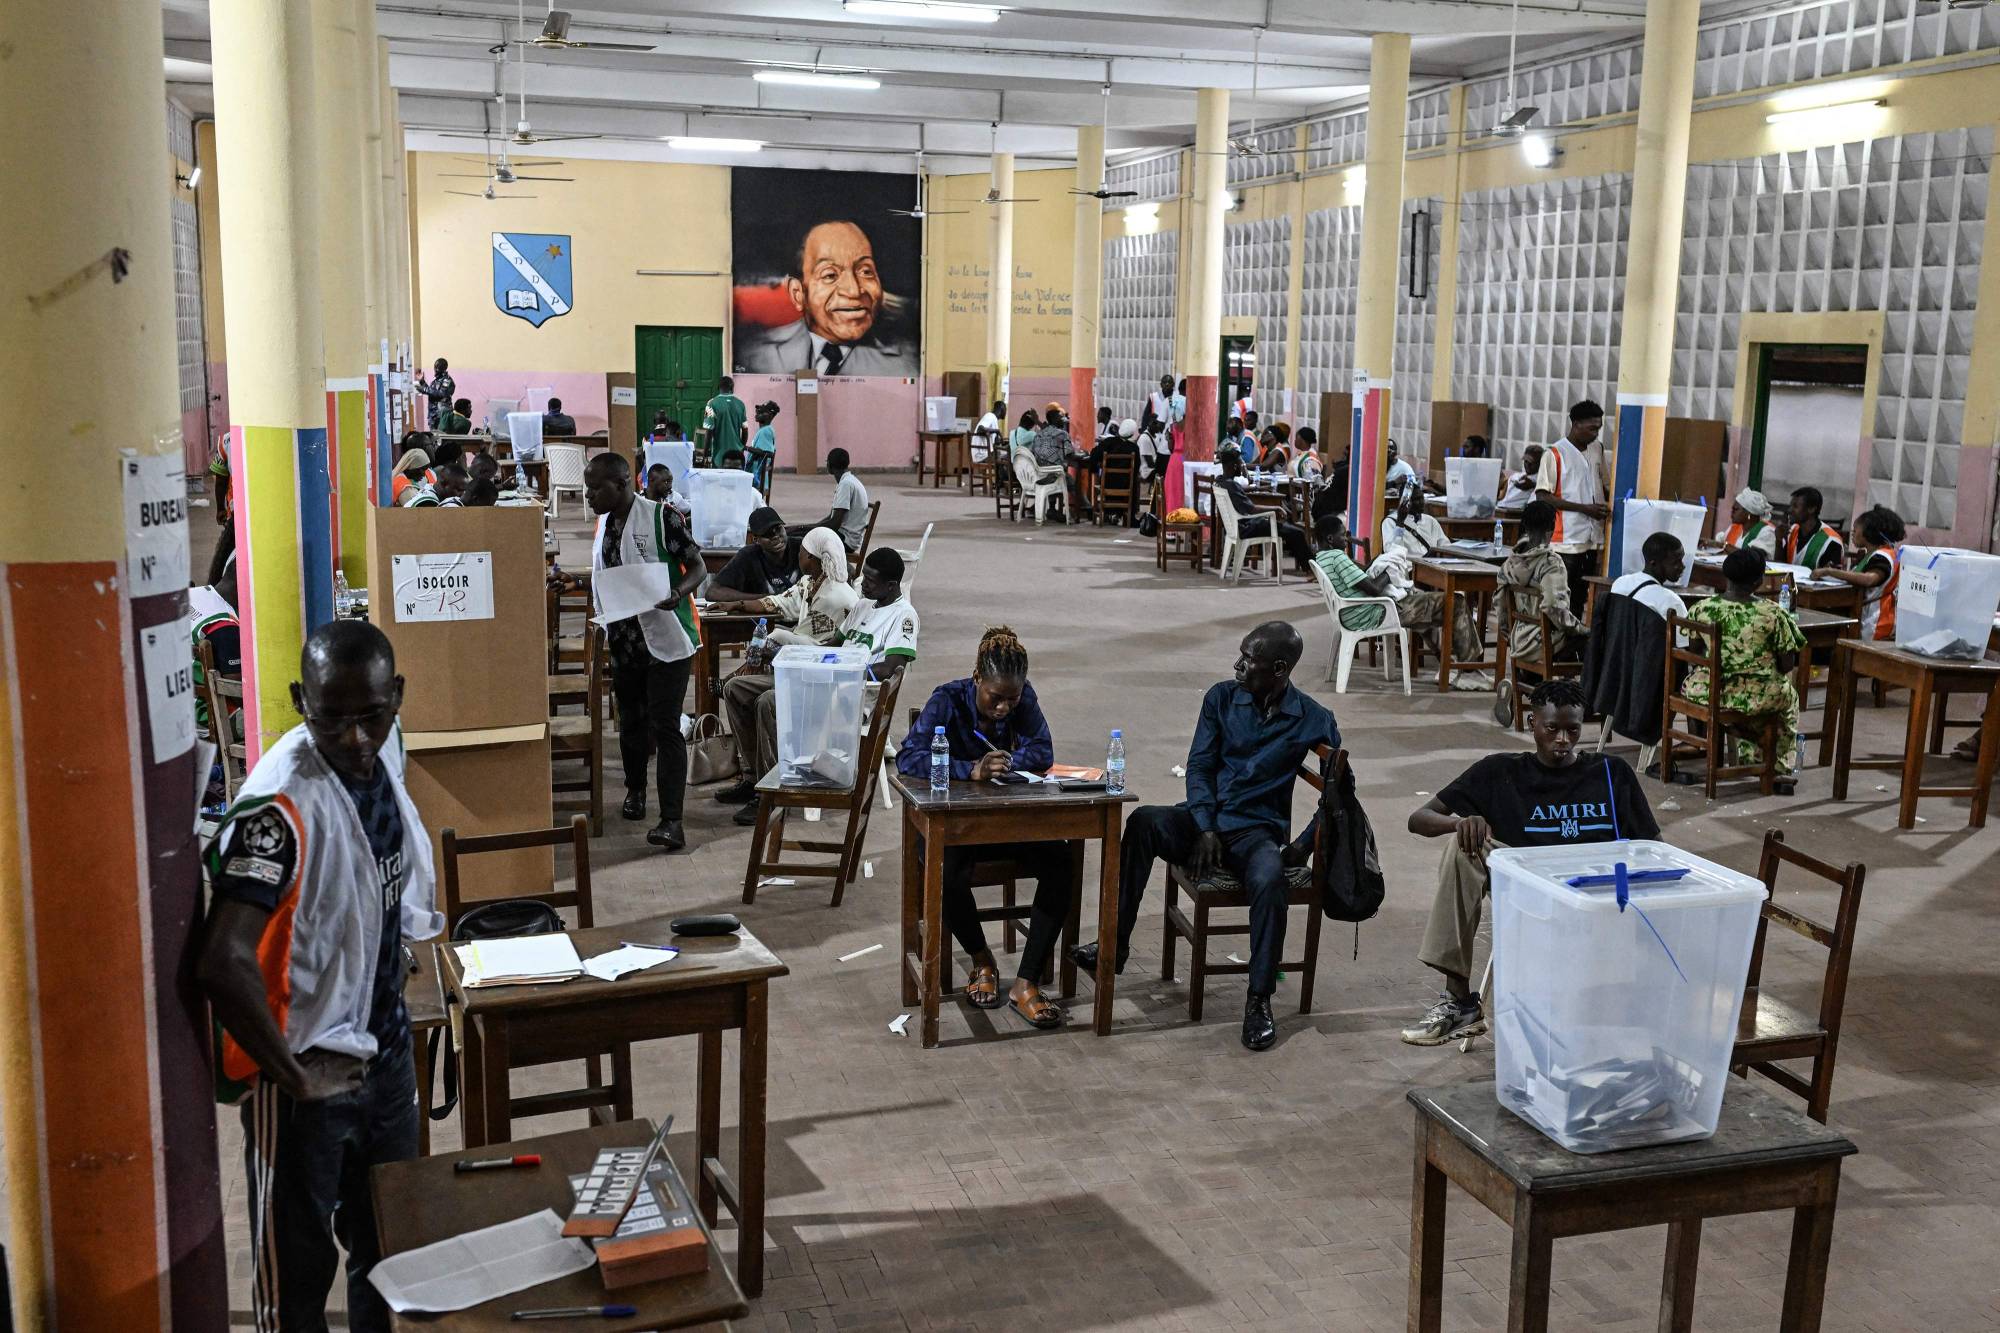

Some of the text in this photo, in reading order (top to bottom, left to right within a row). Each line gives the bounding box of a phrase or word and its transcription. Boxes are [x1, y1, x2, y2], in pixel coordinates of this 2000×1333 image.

[417, 575, 470, 590] ISOLOIR
[438, 590, 466, 613] 12
[1530, 803, 1609, 821] AMIRI
